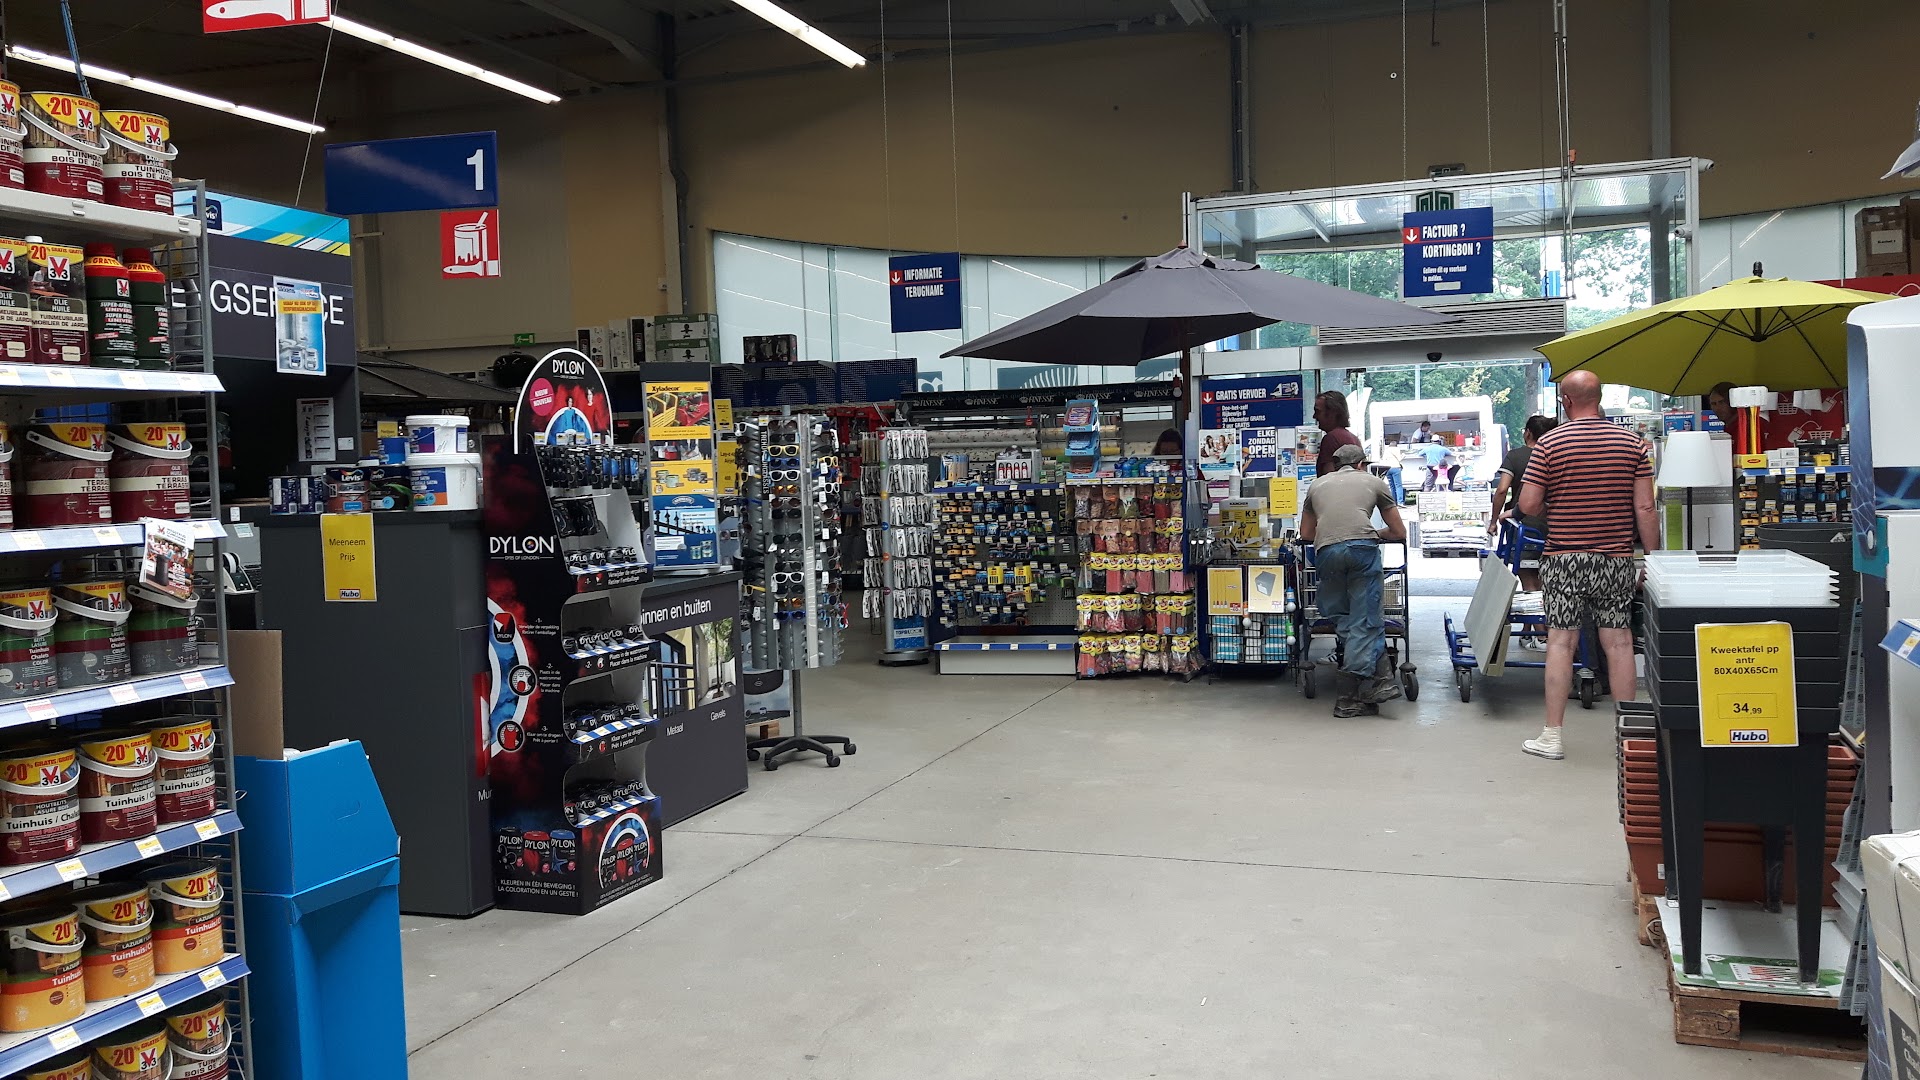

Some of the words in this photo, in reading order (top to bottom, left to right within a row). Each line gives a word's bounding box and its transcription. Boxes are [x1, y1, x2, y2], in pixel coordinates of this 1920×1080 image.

[121, 170, 143, 178] BOIS
[146, 171, 157, 179] DE
[467, 149, 483, 190] 1
[1423, 225, 1458, 238] FACTUUR
[1461, 224, 1466, 236] ?
[1423, 243, 1473, 258] KORTINGBON
[1476, 242, 1481, 255] ?
[904, 267, 942, 281] INFORMATIE
[905, 284, 944, 298] TERUGNAME
[52, 305, 71, 313] HUILE
[553, 360, 585, 375] DYLON
[652, 386, 680, 394] Xyladecor
[1216, 389, 1238, 400] GRATIS
[1239, 388, 1266, 400] VERVOER
[1249, 445, 1275, 454] OPEN
[329, 538, 366, 547] Meeneem
[490, 536, 554, 553] DYLON
[340, 553, 355, 562] Prijs
[341, 590, 359, 598] Hubo
[671, 606, 681, 620] en
[684, 600, 711, 617] buiten
[1711, 646, 1764, 654] Kweektafel
[1767, 646, 1779, 655] pp
[1735, 656, 1755, 664] antr
[1714, 667, 1778, 675] 80X40X65Cm
[710, 709, 726, 721] Gevels
[667, 723, 684, 736] Metaal
[1732, 731, 1767, 741] Hubo
[160, 781, 199, 792] Tuinhuis
[105, 796, 146, 808] Tuinhuis
[6, 818, 53, 831] Tuinhuis
[500, 835, 523, 844] DYLON
[551, 839, 575, 848] DYLON
[525, 841, 550, 850] DYLON
[616, 847, 634, 859] DYLON
[543, 882, 572, 890] BEWEGING
[185, 921, 214, 935] Tuinhuis
[111, 947, 145, 962] Tuinhuis
[185, 1067, 204, 1078] BOIS
